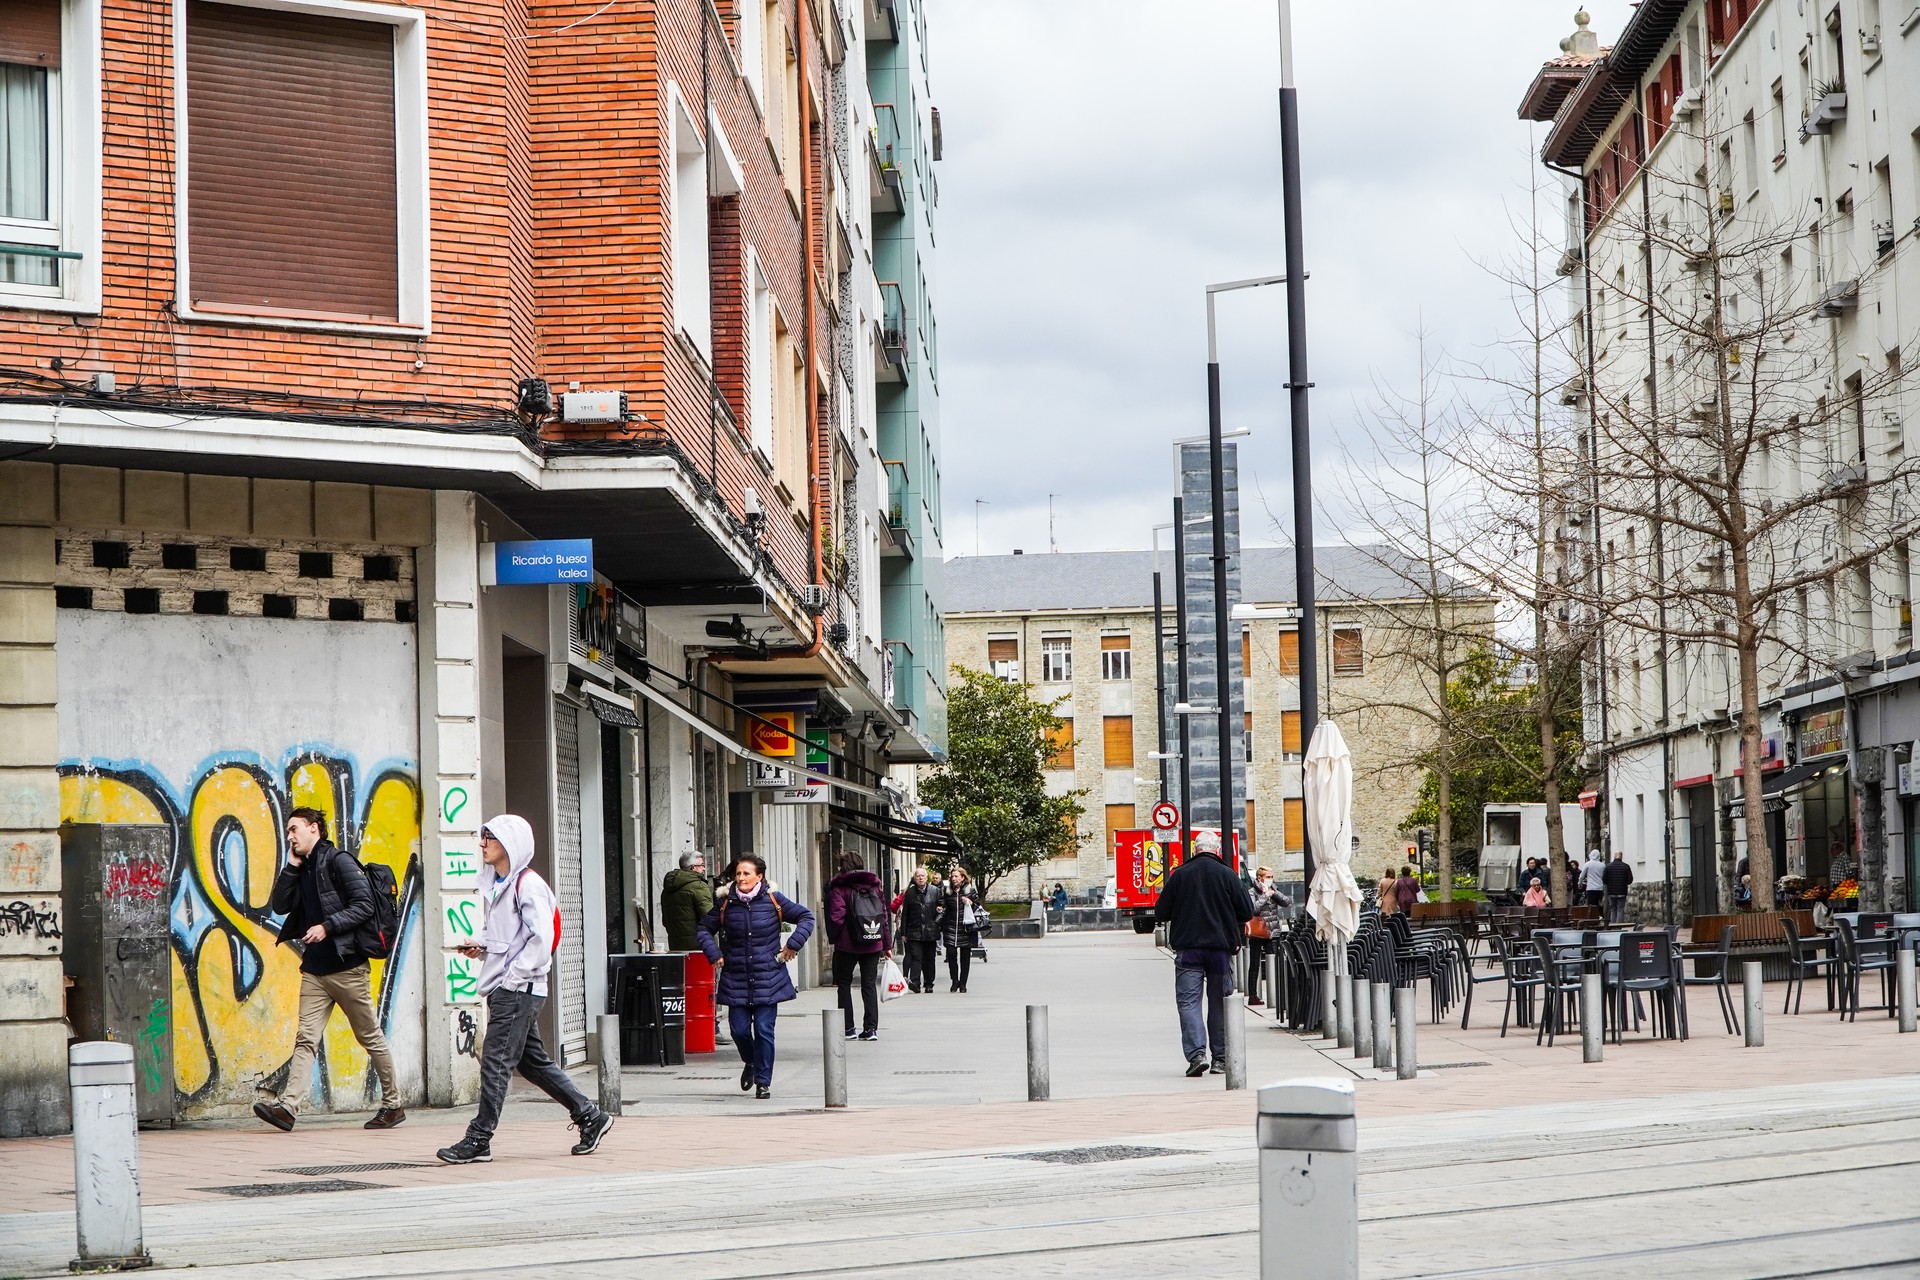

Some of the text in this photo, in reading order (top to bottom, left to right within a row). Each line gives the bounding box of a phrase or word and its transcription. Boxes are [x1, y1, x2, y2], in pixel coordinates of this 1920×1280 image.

[512, 554, 587, 566] Ricardo Buesa
[558, 568, 587, 578] kalea
